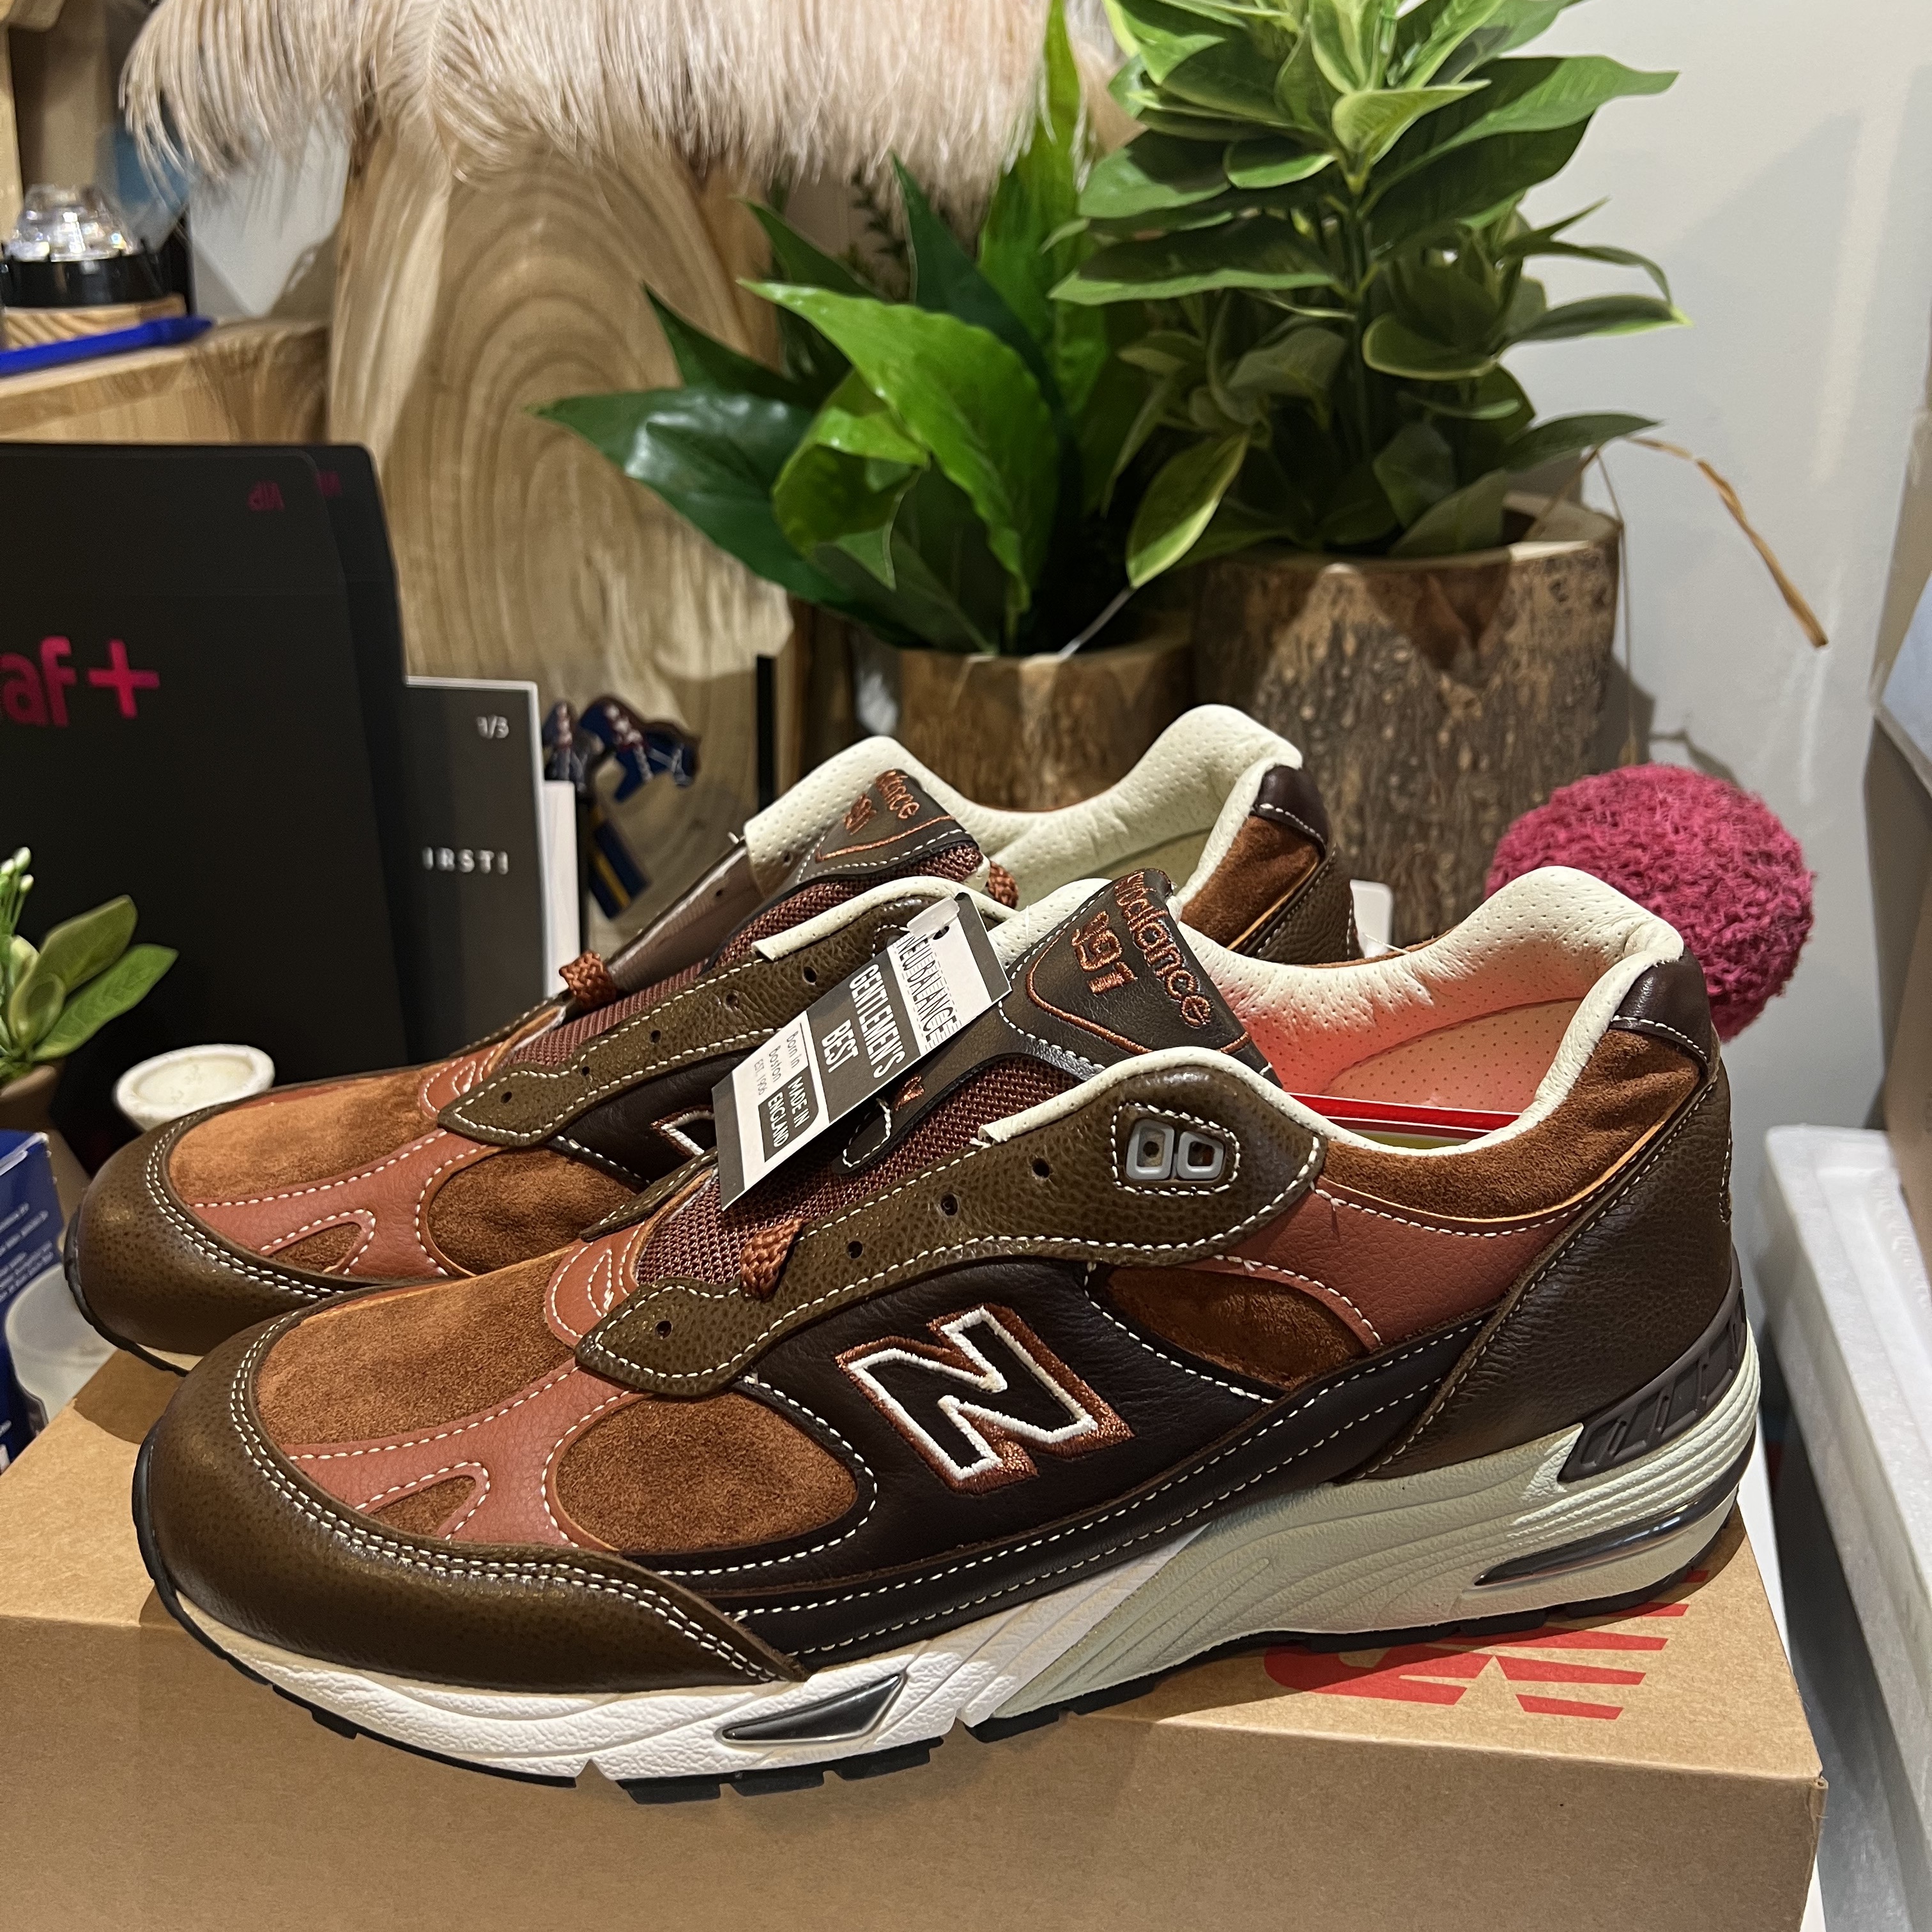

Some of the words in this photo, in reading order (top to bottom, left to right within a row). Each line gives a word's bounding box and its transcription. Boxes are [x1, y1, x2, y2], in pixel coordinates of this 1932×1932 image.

[896, 933, 933, 971] NEW
[848, 963, 905, 1079] GENTLEMEN'S
[907, 960, 957, 1043] BALANCE
[790, 1053, 802, 1069] in
[822, 1019, 859, 1073] BEST
[756, 1074, 767, 1096] 1906
[787, 1076, 808, 1115] MADE
[767, 1091, 790, 1148] ENGLAND
[793, 1108, 810, 1128] IN
[835, 1302, 1135, 1495] N
